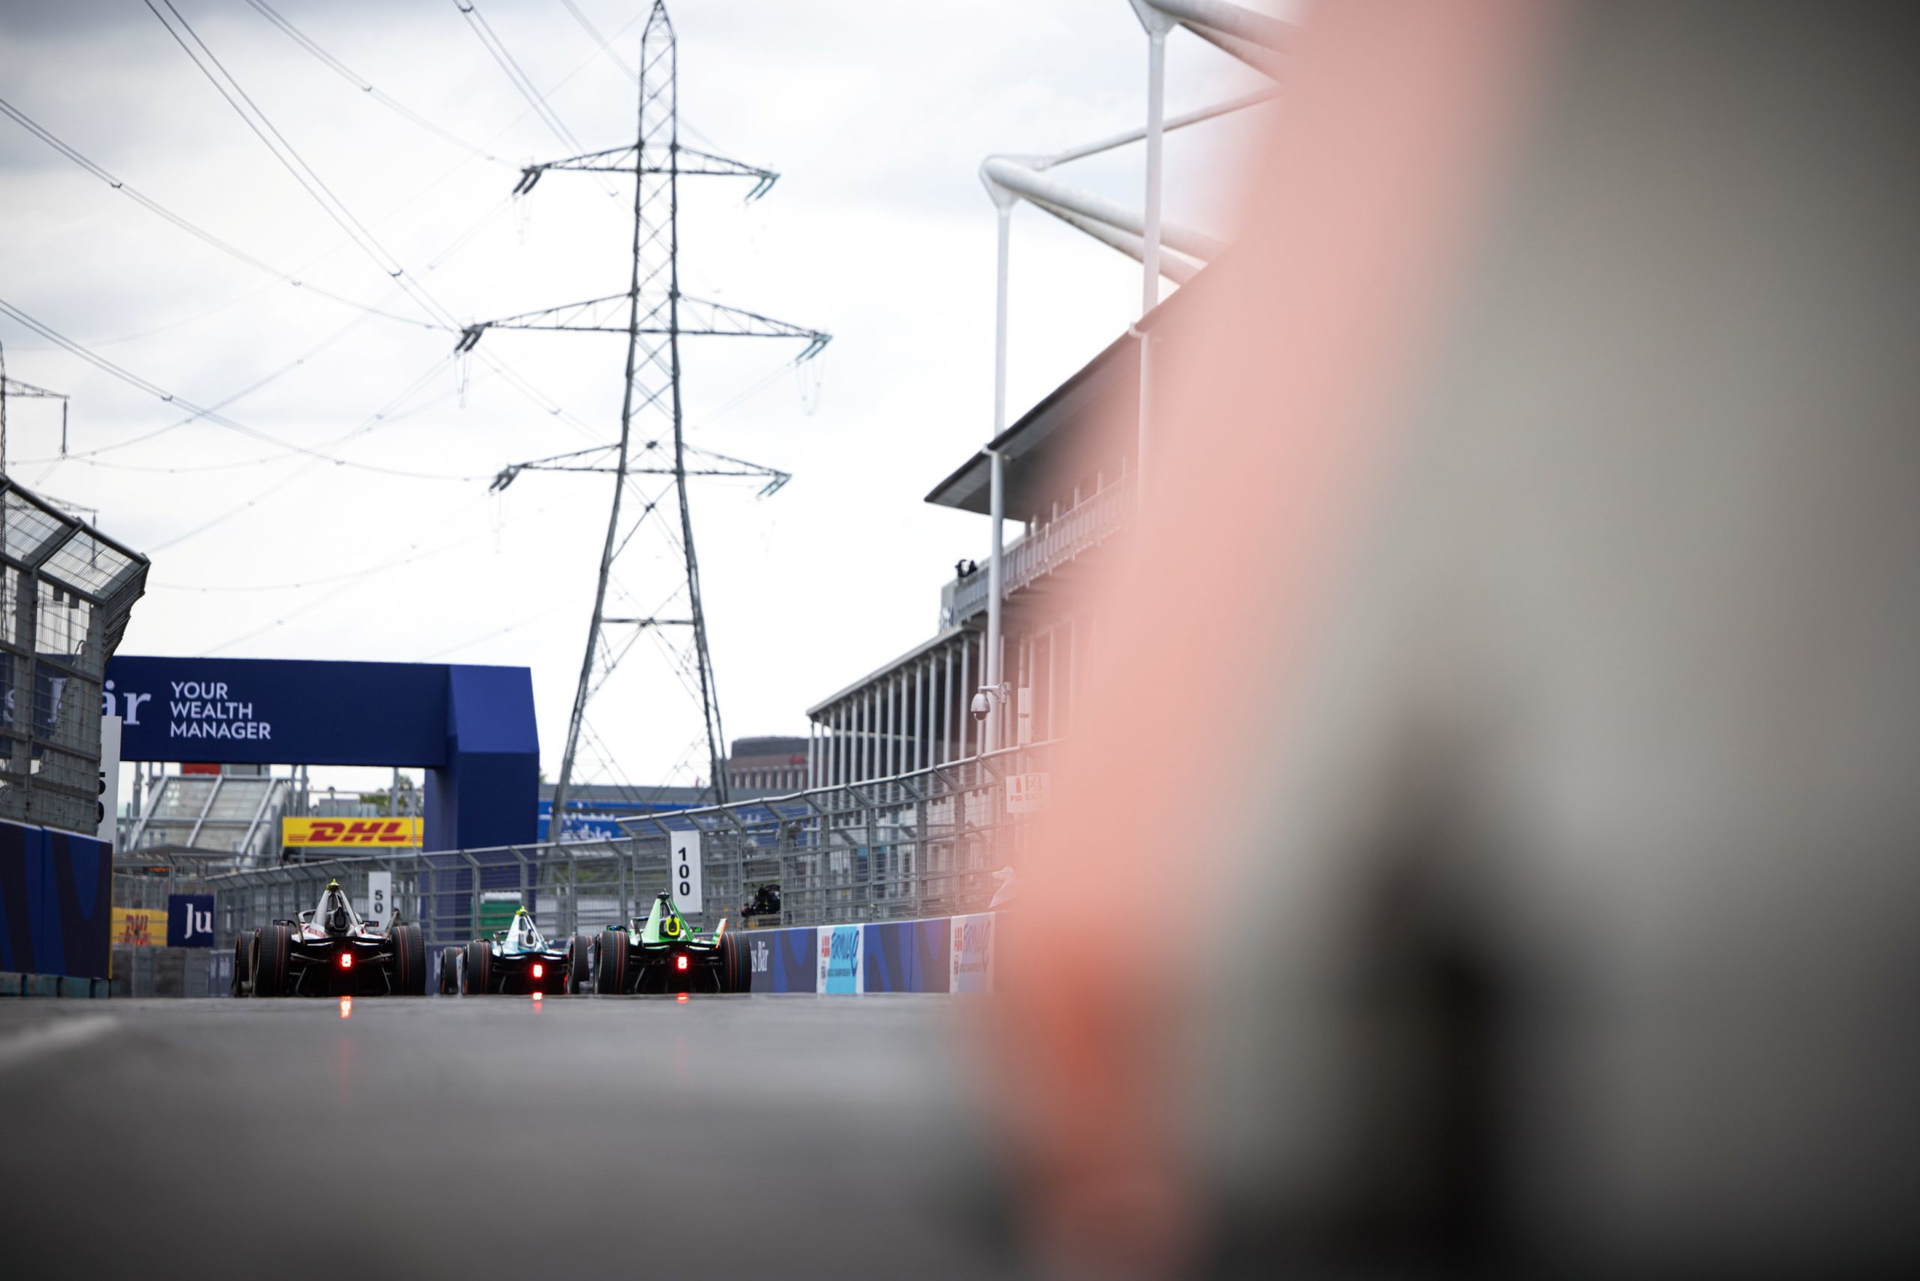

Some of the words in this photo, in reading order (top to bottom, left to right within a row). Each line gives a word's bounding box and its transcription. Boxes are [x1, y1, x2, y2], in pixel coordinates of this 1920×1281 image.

[171, 681, 228, 699] YOUR
[170, 701, 252, 719] WEALTH
[170, 721, 271, 739] MANAGER
[308, 822, 407, 842] DHL
[678, 847, 690, 896] 100
[374, 890, 383, 914] 50
